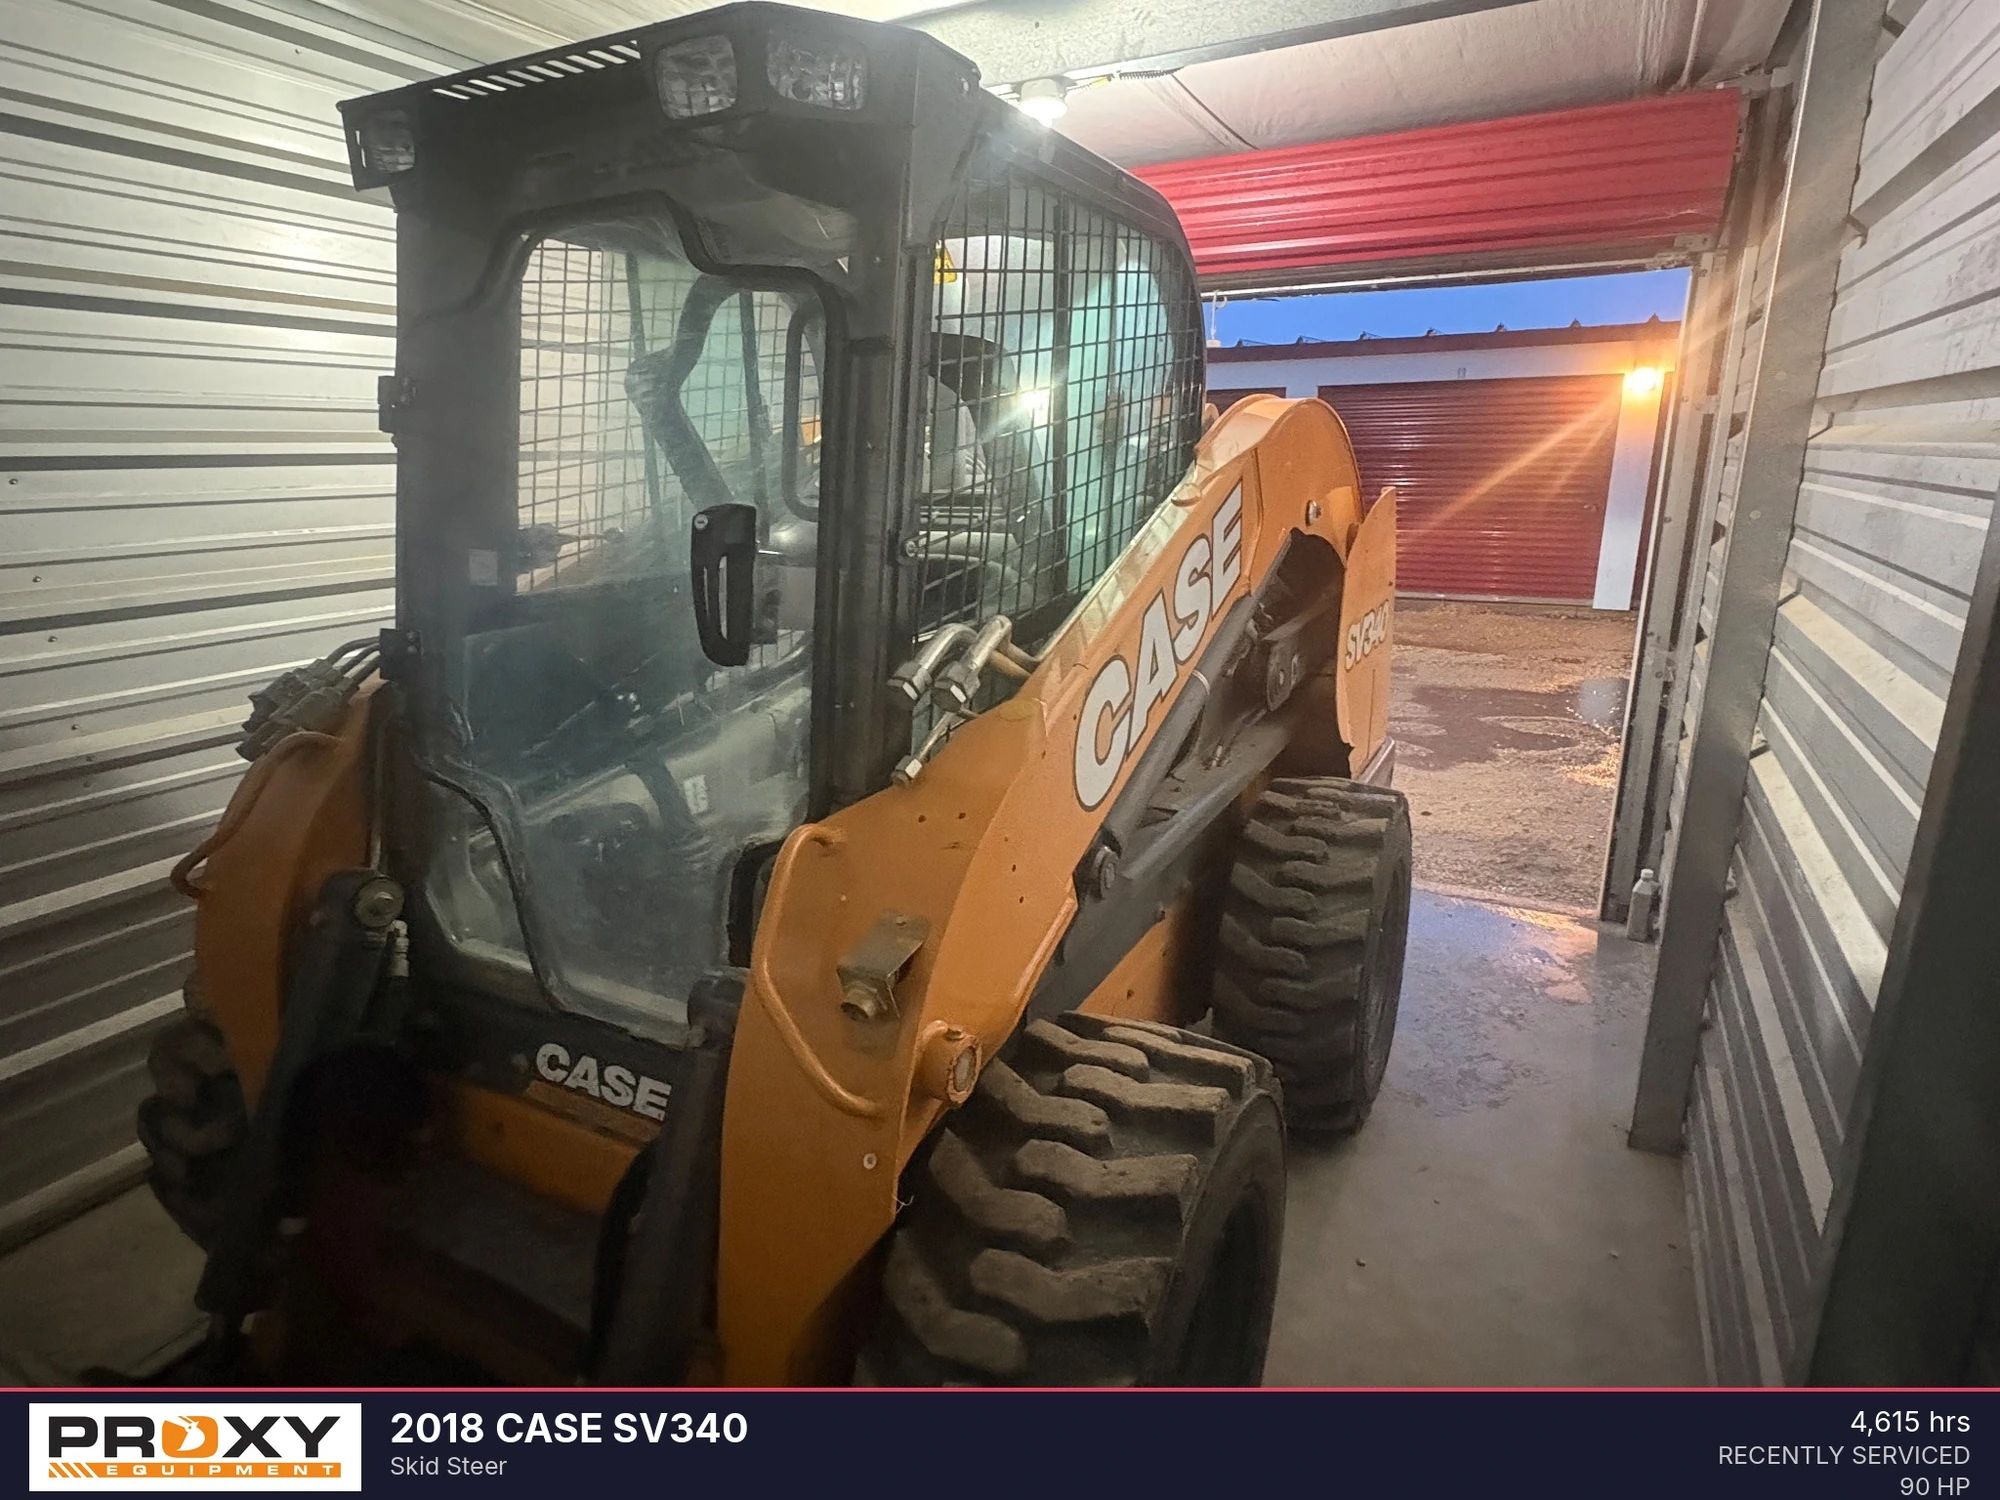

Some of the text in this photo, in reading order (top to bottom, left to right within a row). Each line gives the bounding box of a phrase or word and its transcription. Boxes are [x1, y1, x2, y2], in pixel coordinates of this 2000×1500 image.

[1074, 479, 1244, 811] CASE
[1344, 599, 1390, 673] SV340
[536, 1043, 672, 1122] CASE
